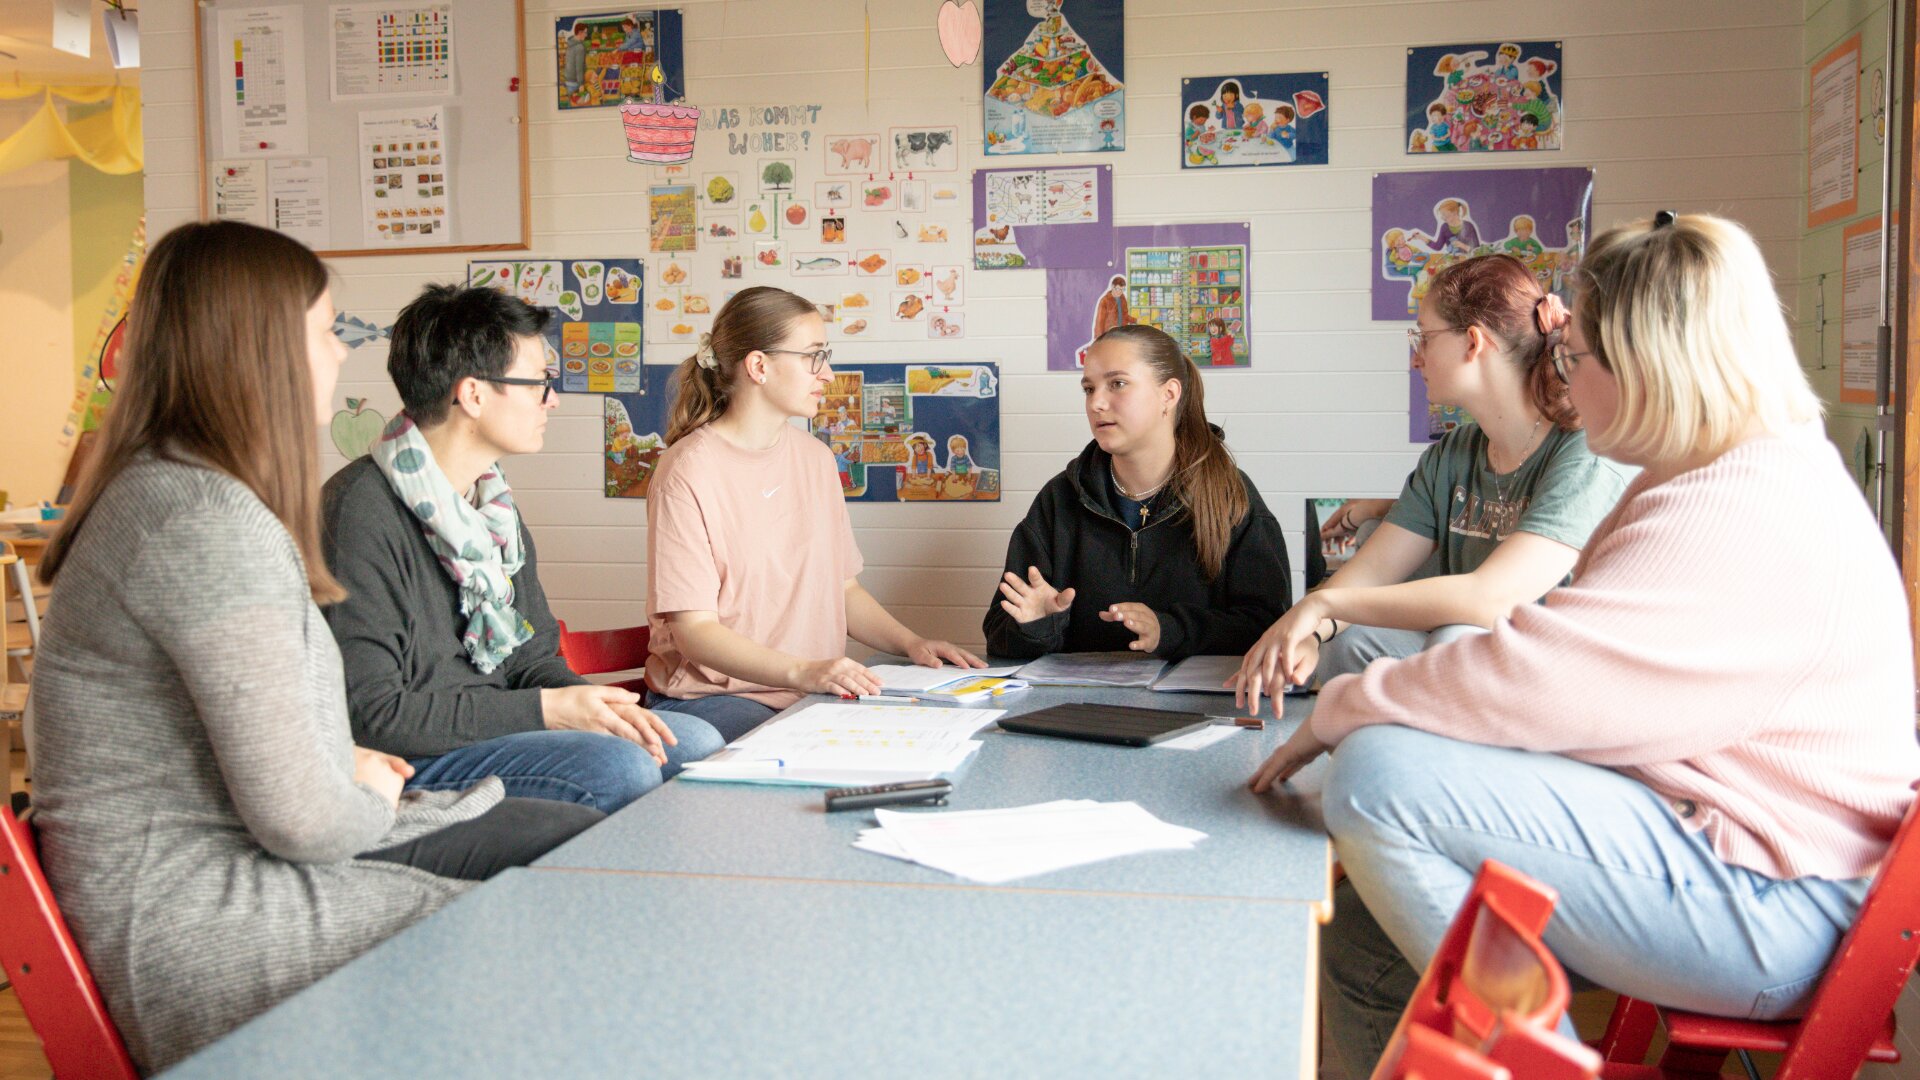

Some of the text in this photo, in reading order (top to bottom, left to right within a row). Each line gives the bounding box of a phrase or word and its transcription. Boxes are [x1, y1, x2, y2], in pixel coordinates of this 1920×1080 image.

[699, 104, 822, 131] WAS KOMMT
[728, 130, 811, 155] WOHER?
